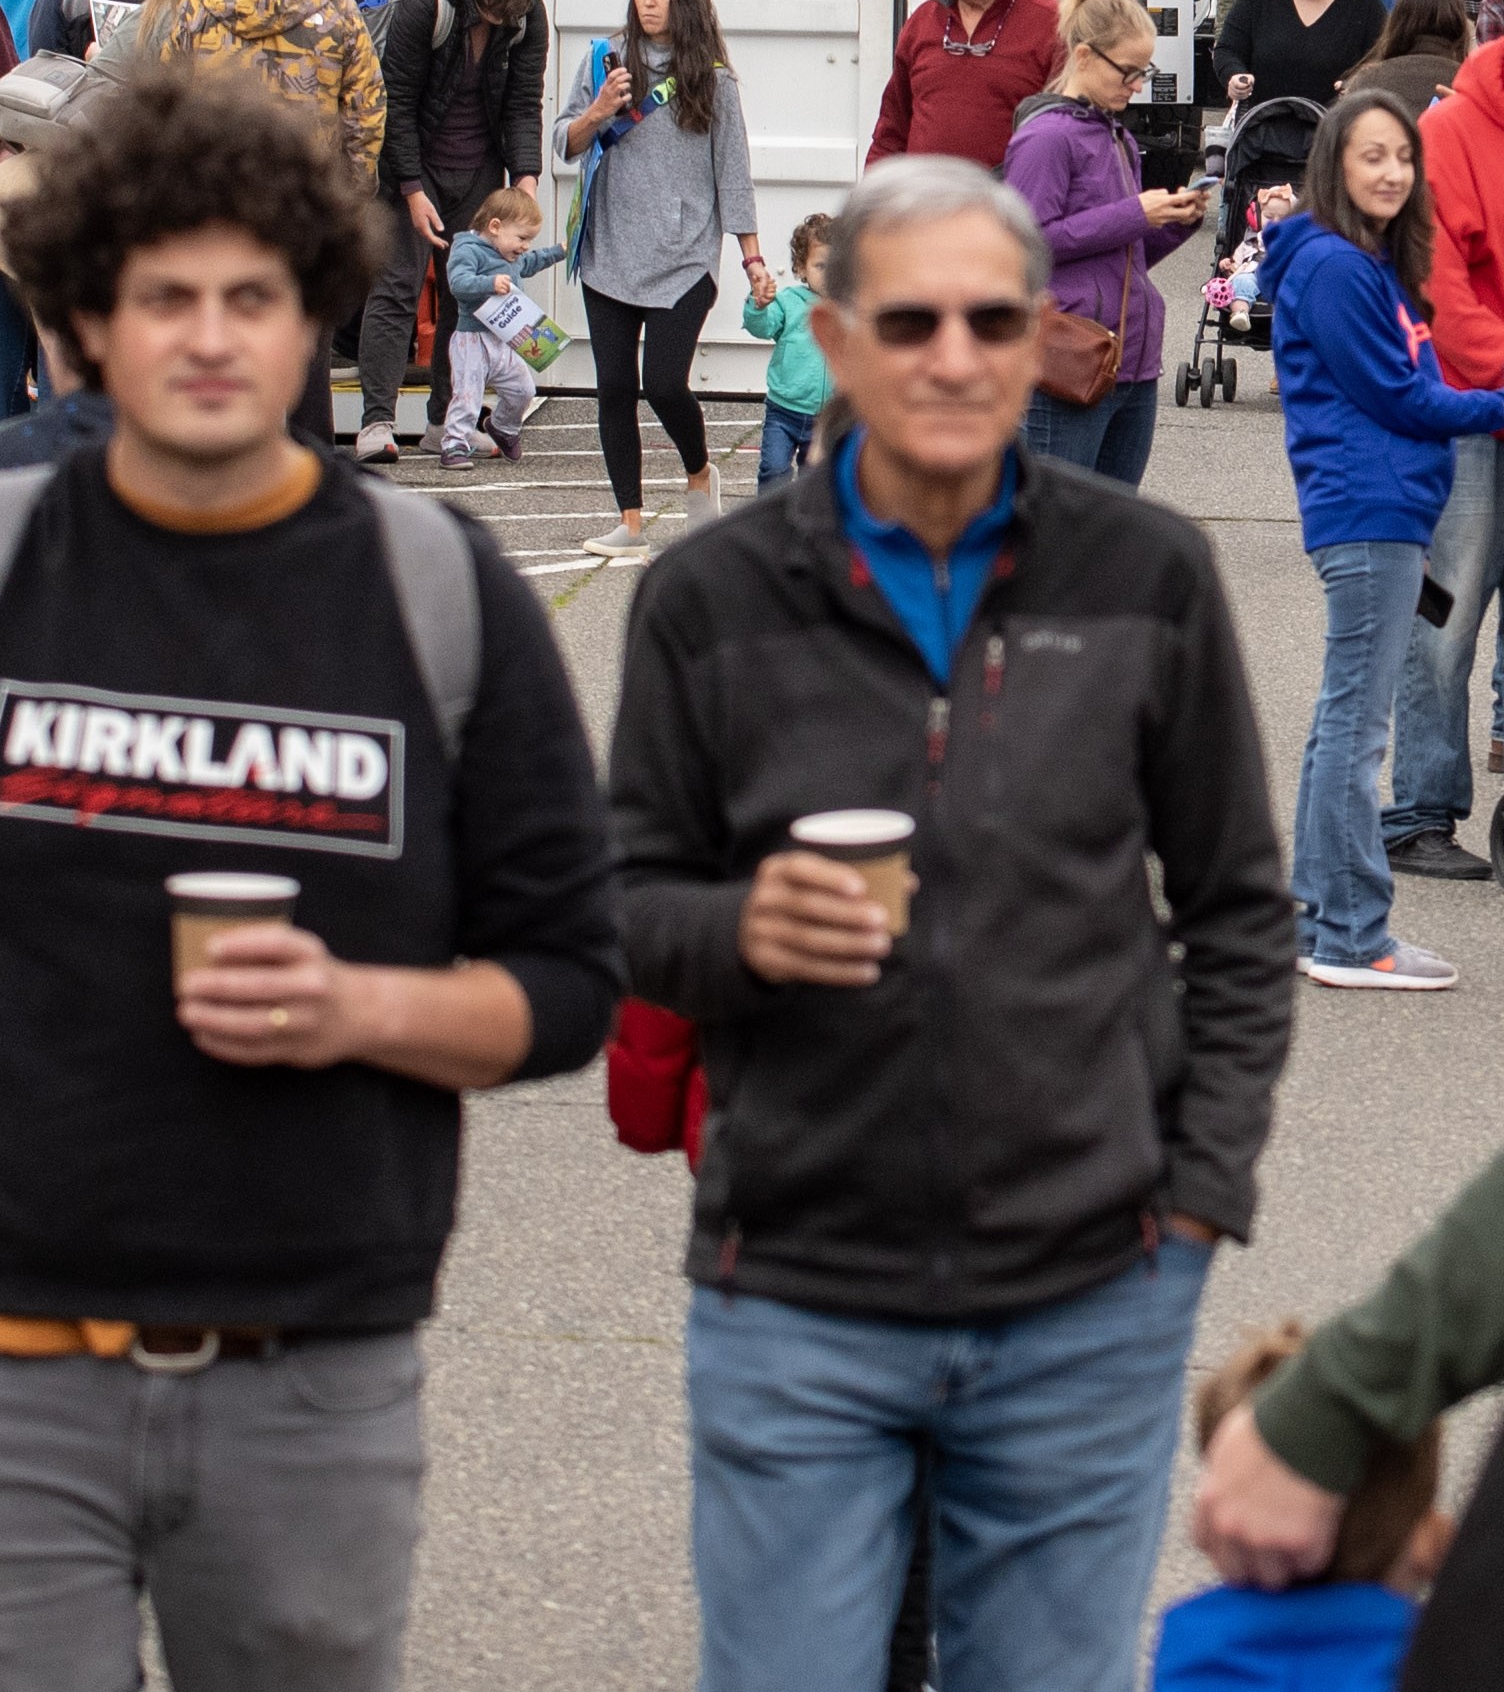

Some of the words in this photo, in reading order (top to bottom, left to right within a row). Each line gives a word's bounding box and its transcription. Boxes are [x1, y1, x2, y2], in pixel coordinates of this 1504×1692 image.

[488, 295, 520, 326] Recycling
[498, 305, 523, 329] Guide
[3, 698, 389, 802] KIRKLAND
